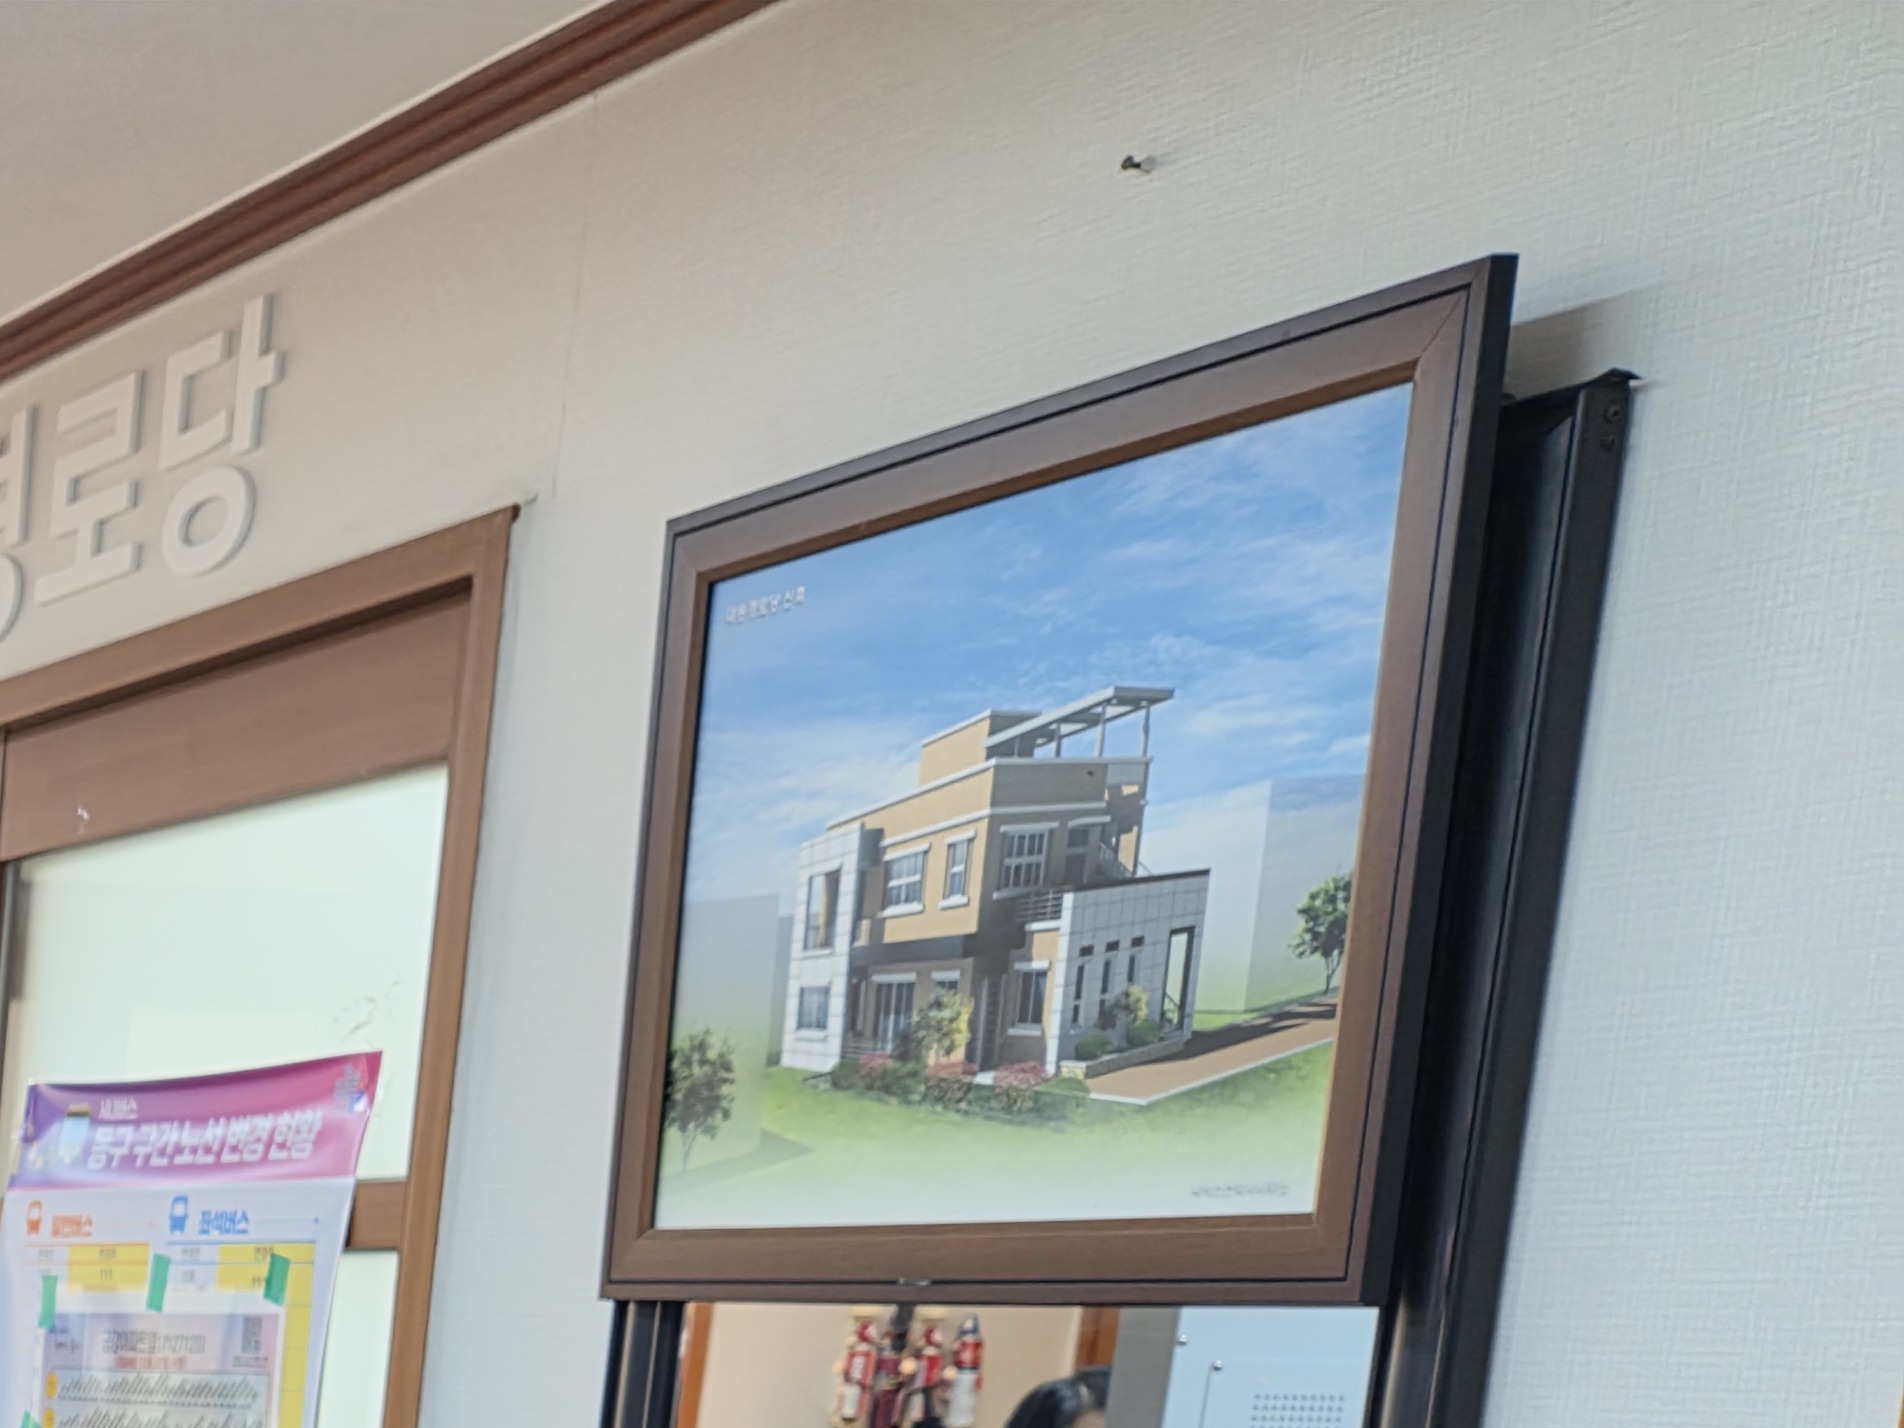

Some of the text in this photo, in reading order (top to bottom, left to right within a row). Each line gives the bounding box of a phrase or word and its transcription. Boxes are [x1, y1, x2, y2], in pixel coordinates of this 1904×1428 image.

[86, 1124, 134, 1170] 동구
[173, 1116, 225, 1166] 노선
[220, 1112, 276, 1164] 변경
[268, 1108, 324, 1161] 현황
[197, 1208, 250, 1236] 좌석버스
